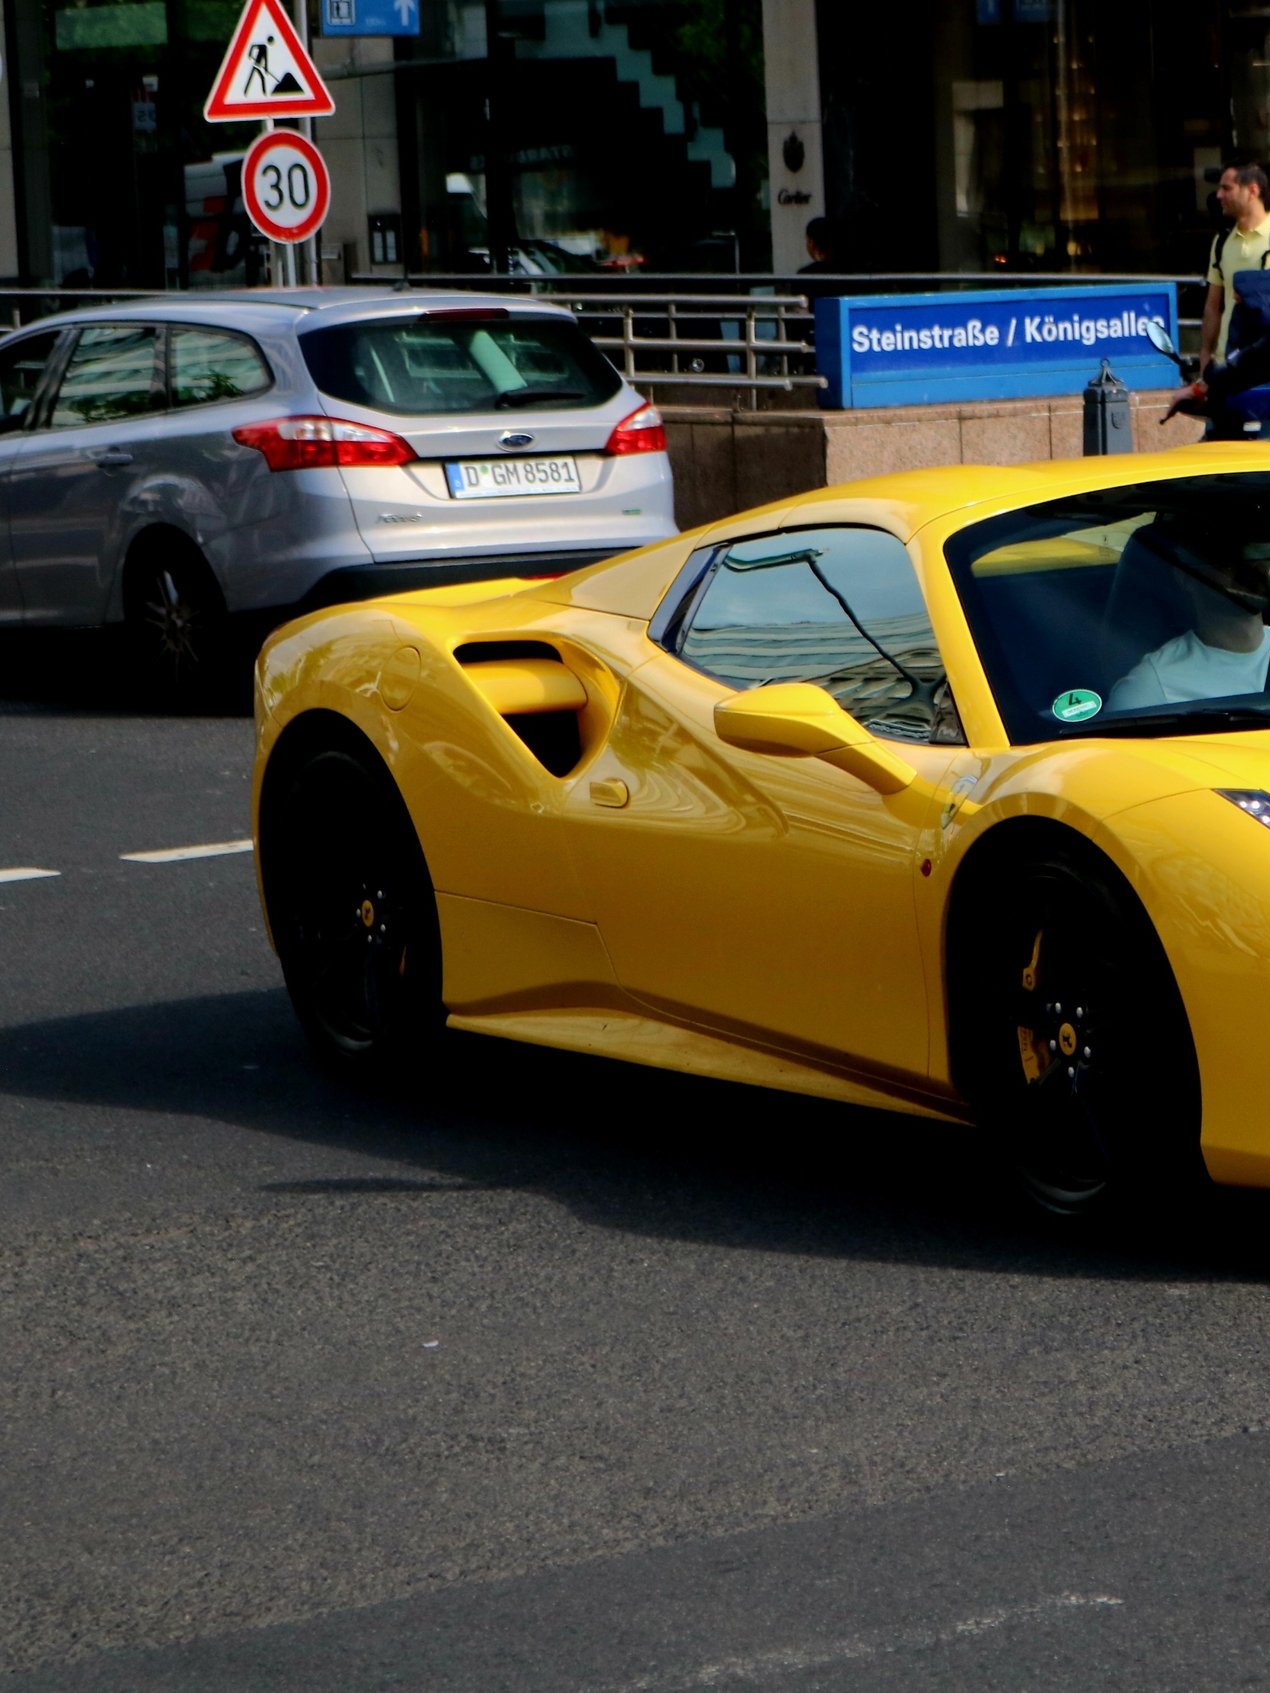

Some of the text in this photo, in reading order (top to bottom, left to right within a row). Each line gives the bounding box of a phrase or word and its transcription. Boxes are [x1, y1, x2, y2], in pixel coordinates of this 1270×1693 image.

[262, 163, 309, 211] 30
[852, 319, 999, 352] Steinstraße
[464, 461, 575, 487] D GM 8581
[1068, 693, 1081, 705] 4
